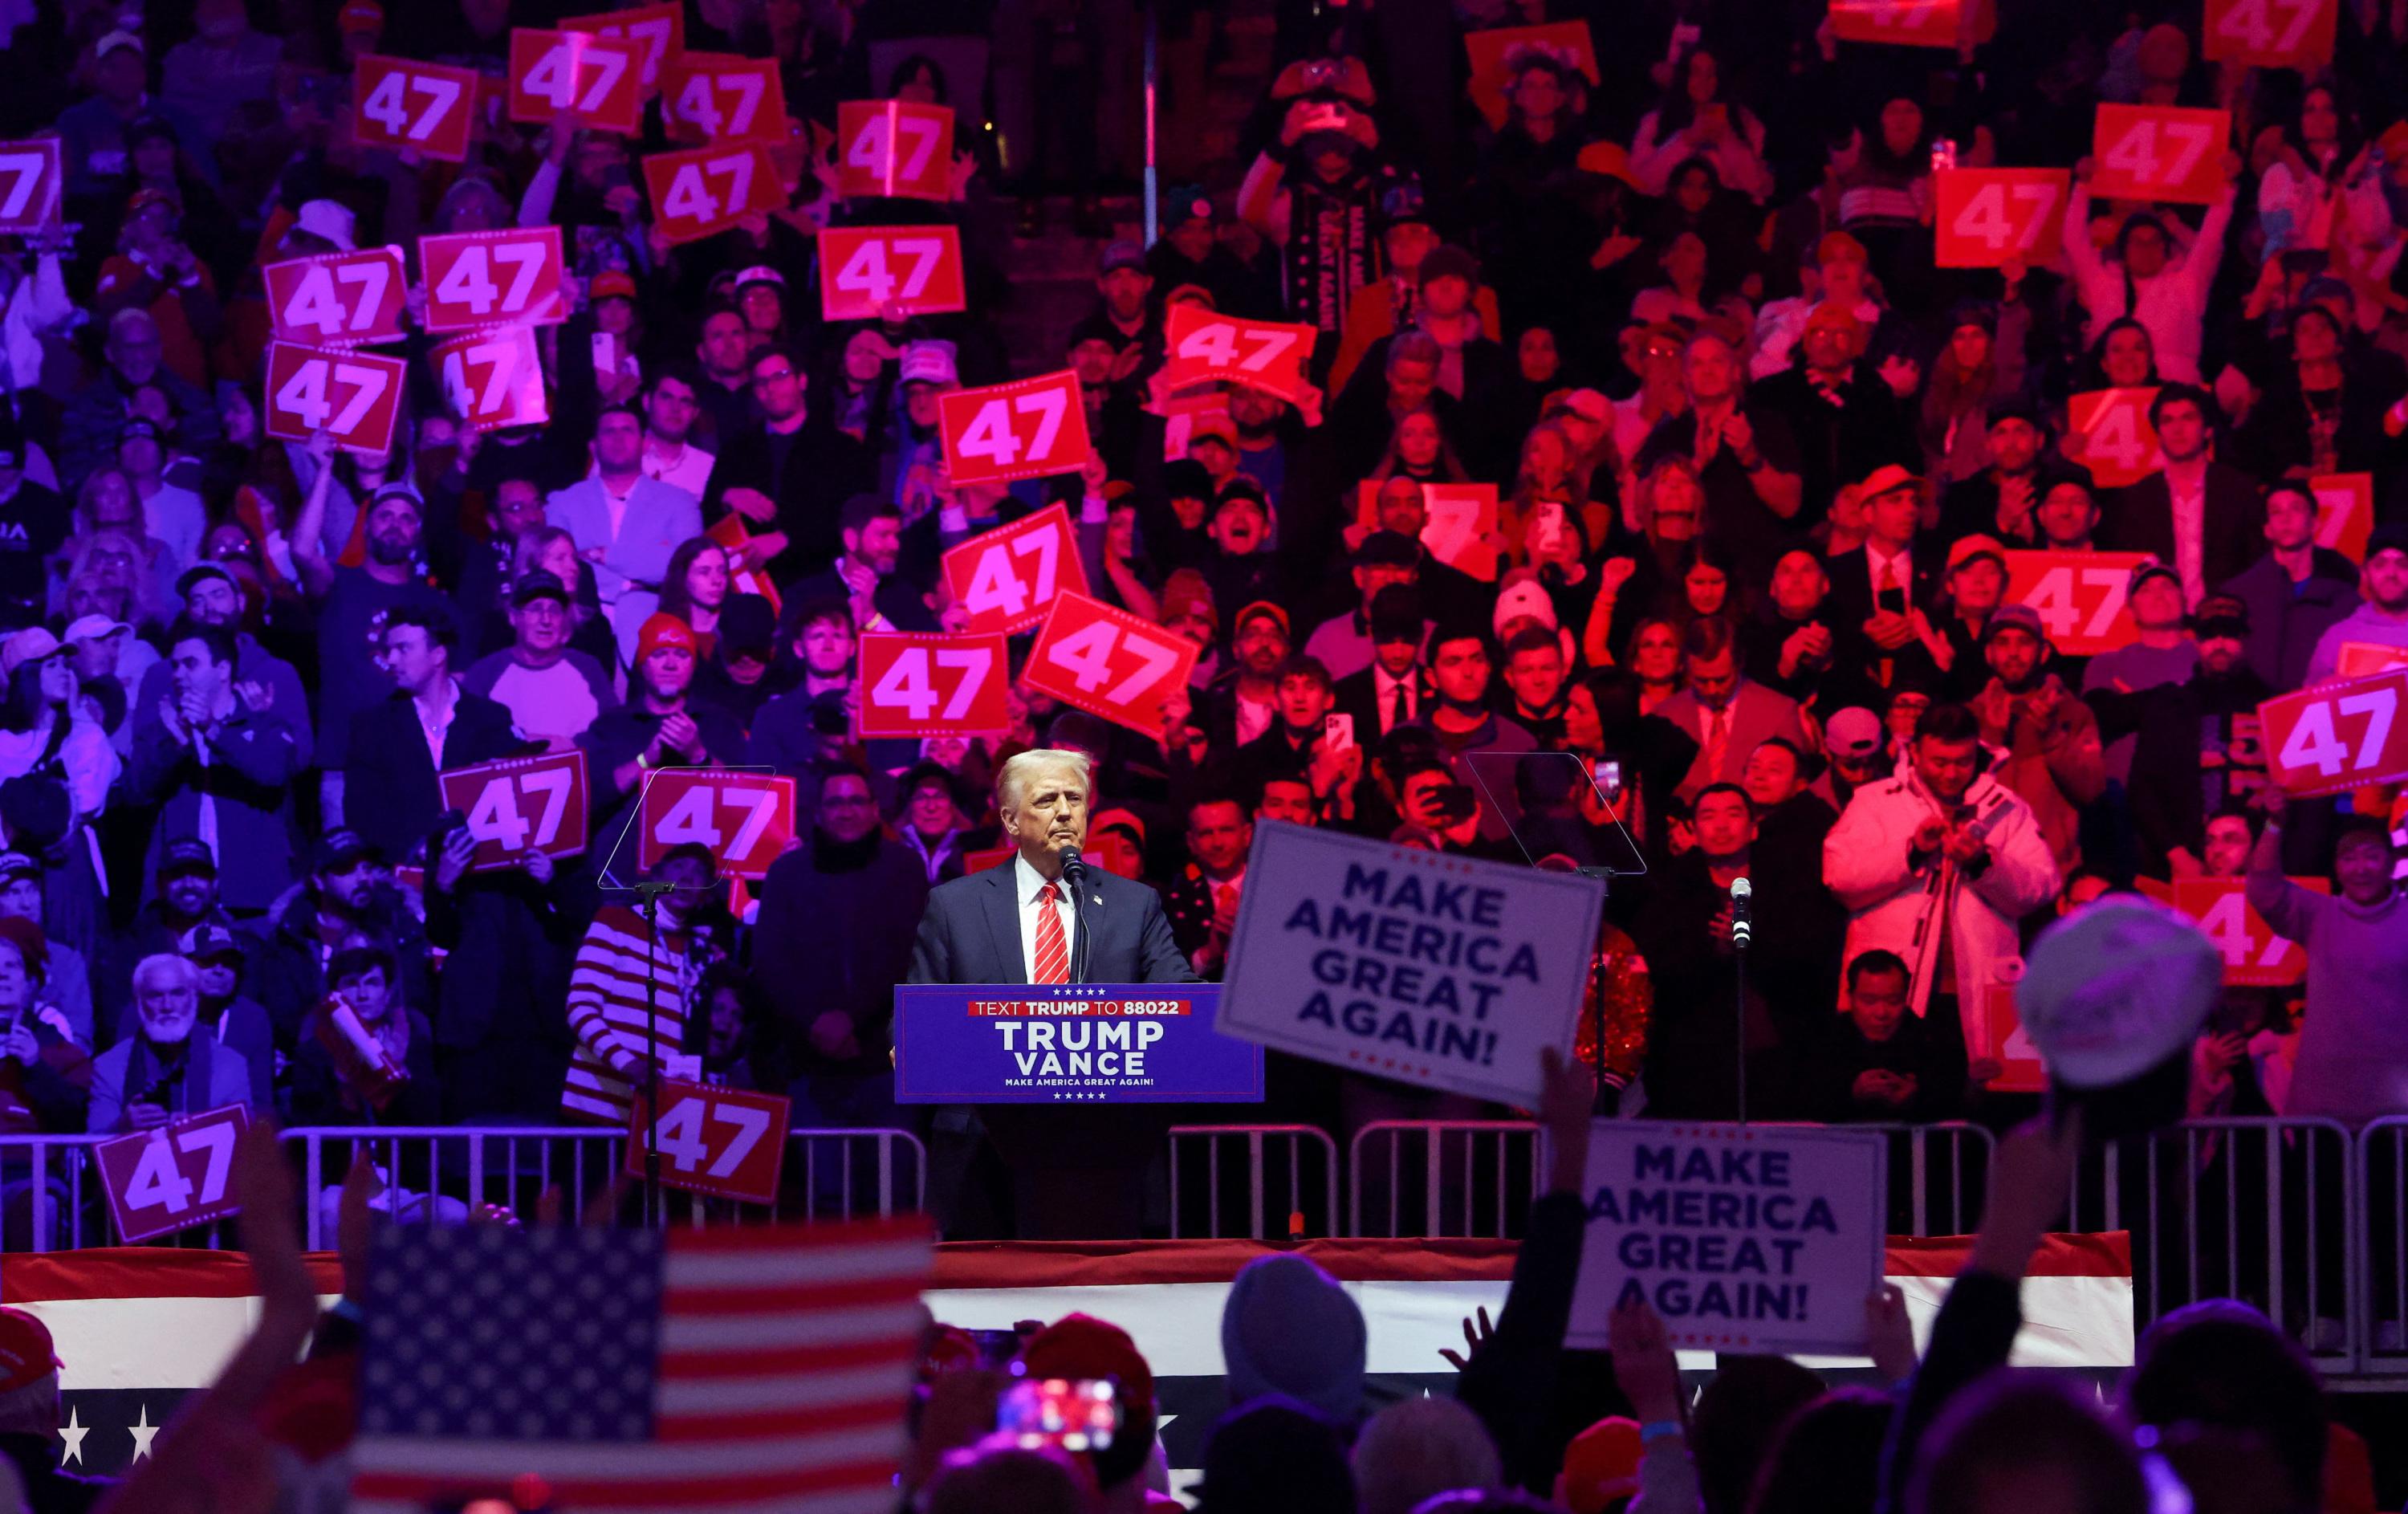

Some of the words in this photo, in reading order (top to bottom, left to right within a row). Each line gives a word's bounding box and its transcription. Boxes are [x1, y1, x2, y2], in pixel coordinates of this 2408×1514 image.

[2218, 0, 2321, 51] 47
[364, 71, 461, 140] 47
[522, 44, 628, 111] 47
[676, 74, 765, 135] 47
[847, 115, 942, 181] 47
[2106, 121, 2213, 185] 47
[0, 153, 44, 218] 7
[663, 153, 754, 223] 47
[1953, 183, 2059, 249] 47
[283, 262, 389, 334] 47
[436, 242, 546, 313] 47
[836, 239, 942, 307] 47
[1177, 323, 1298, 371] 47
[275, 358, 388, 435] 47
[957, 387, 1068, 465] 47
[2316, 489, 2355, 544] 7
[966, 523, 1059, 616] 47
[2020, 567, 2131, 637] 47
[871, 647, 993, 719] 47
[1047, 621, 1179, 705] 47
[2280, 687, 2397, 777] 47
[466, 767, 572, 851] 47
[654, 785, 778, 861] 47
[1343, 861, 1507, 929] MAKE
[1285, 898, 1540, 983] AMERICA
[975, 1002, 1019, 1015] TEXT
[1025, 1002, 1089, 1015] TRUMP
[1094, 1002, 1118, 1015] TO
[1123, 1001, 1179, 1015] 88022
[1312, 949, 1503, 1020] GREAT
[995, 1020, 1164, 1051] TRUMP
[1297, 990, 1499, 1067] AGAIN!
[1005, 1078, 1034, 1086] MAKE
[1036, 1078, 1081, 1086] AMERICA
[1084, 1078, 1117, 1086] GREAT
[1119, 1078, 1154, 1086] AGAIN!
[1014, 1052, 1145, 1076] VANCE
[124, 1122, 239, 1215] 47
[643, 1096, 771, 1178] 47
[1634, 1144, 1791, 1187] MAKE
[1586, 1186, 1839, 1235] AMERICA
[1618, 1231, 1804, 1275] GREAT
[1615, 1277, 1809, 1322] AGAIN!
